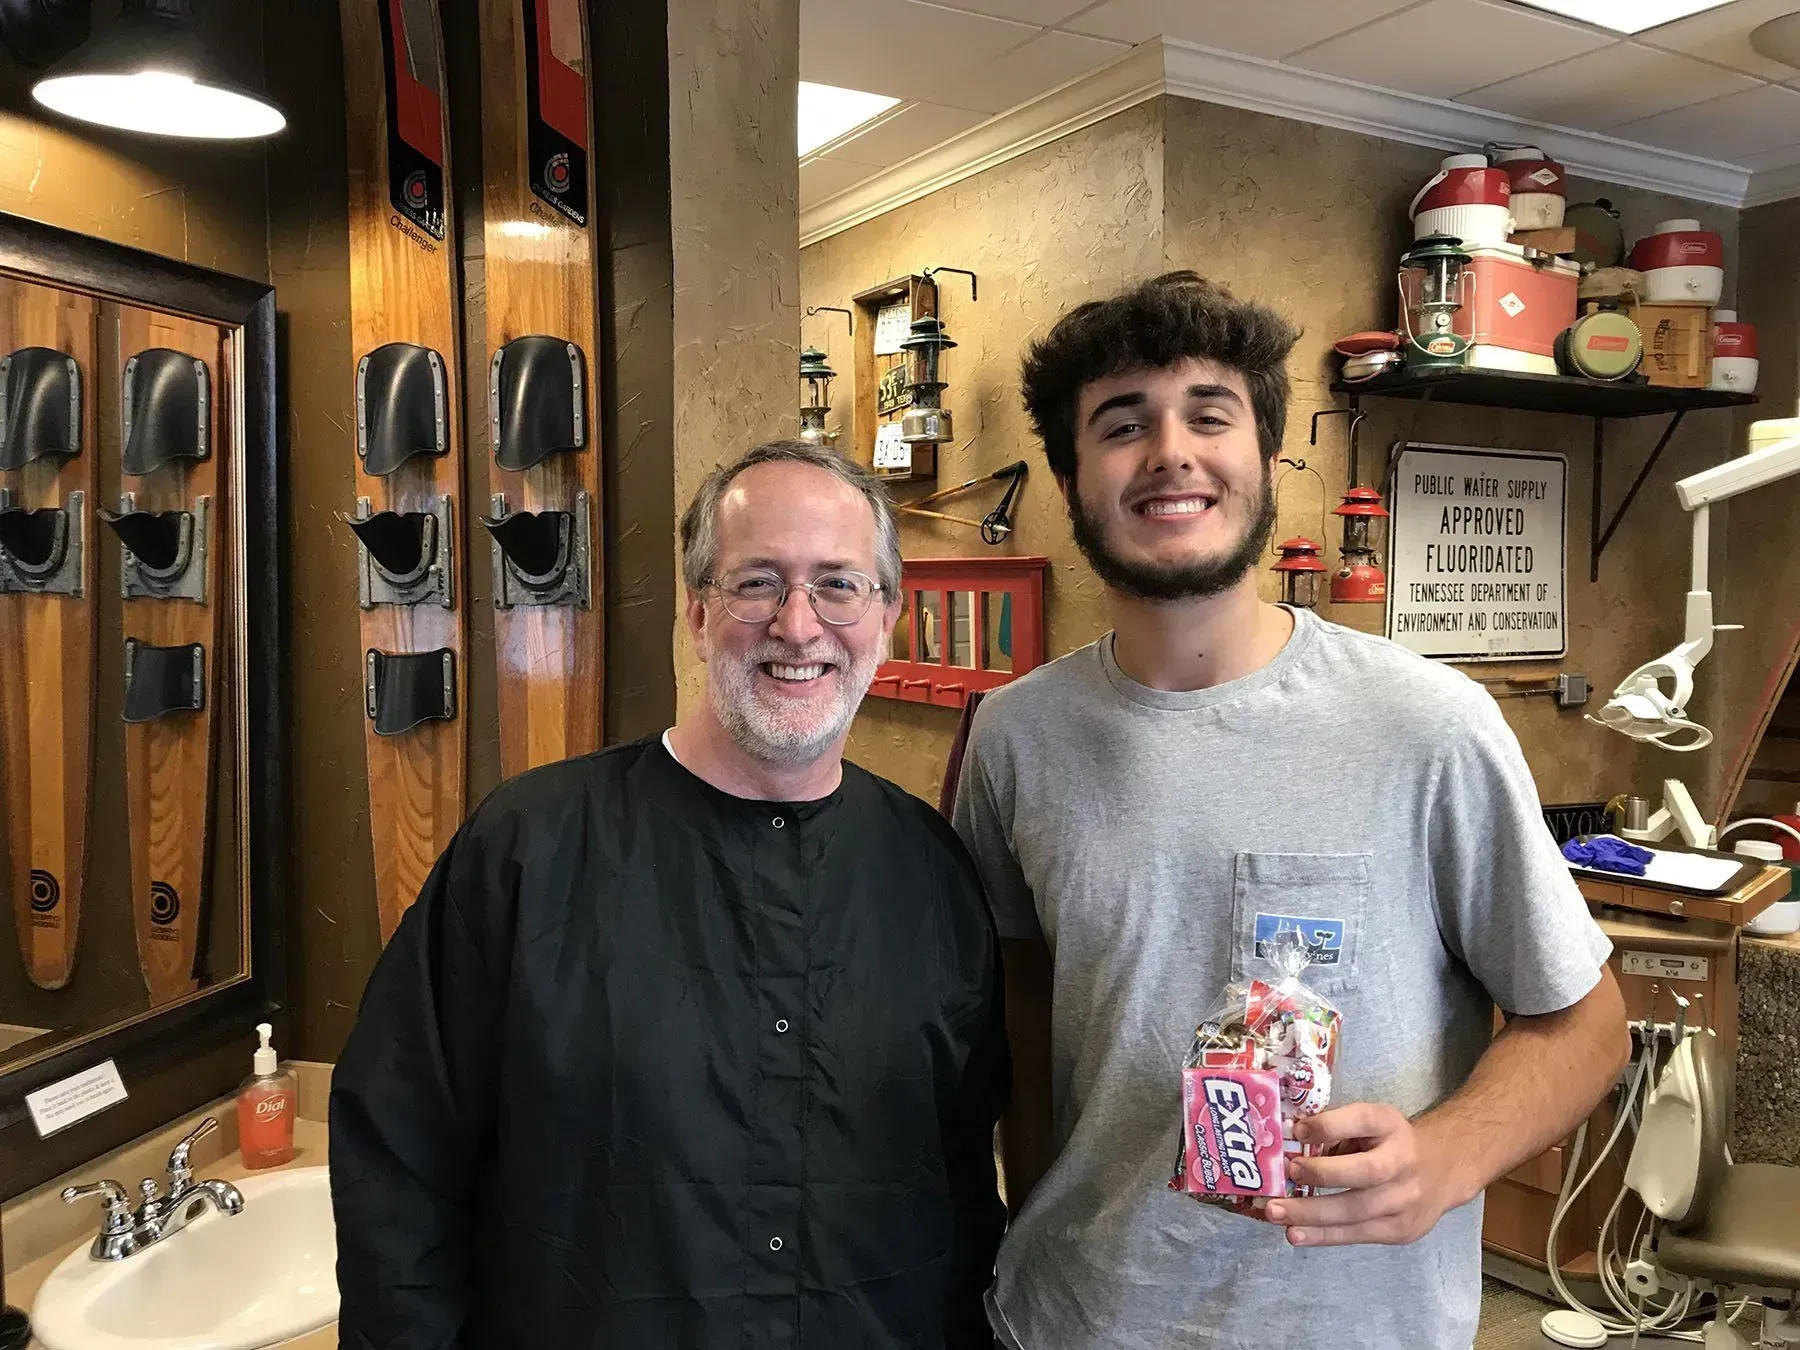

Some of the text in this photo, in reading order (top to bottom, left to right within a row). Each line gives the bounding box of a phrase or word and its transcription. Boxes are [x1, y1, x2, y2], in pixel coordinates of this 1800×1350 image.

[529, 201, 580, 243] Challeer
[557, 200, 585, 224] GARDENS
[390, 215, 438, 254] Challenger
[1653, 318, 1671, 350] RIVERS
[1415, 474, 1547, 500] PUBLIC WATER SUPPLY
[1440, 506, 1524, 535] APPROVED
[1426, 544, 1533, 573] FLUORIDATED
[1410, 583, 1548, 602] TENNESSEE DEPARTMENT OF
[1397, 611, 1558, 632] ENVIRONMENT AND CONSERVATION
[256, 1098, 285, 1115] Dial
[1209, 1106, 1220, 1125] LONG
[1204, 1079, 1262, 1190] Extra
[1213, 1124, 1226, 1151] LASTING
[1195, 1124, 1216, 1191] CLASSIC BUBBLE
